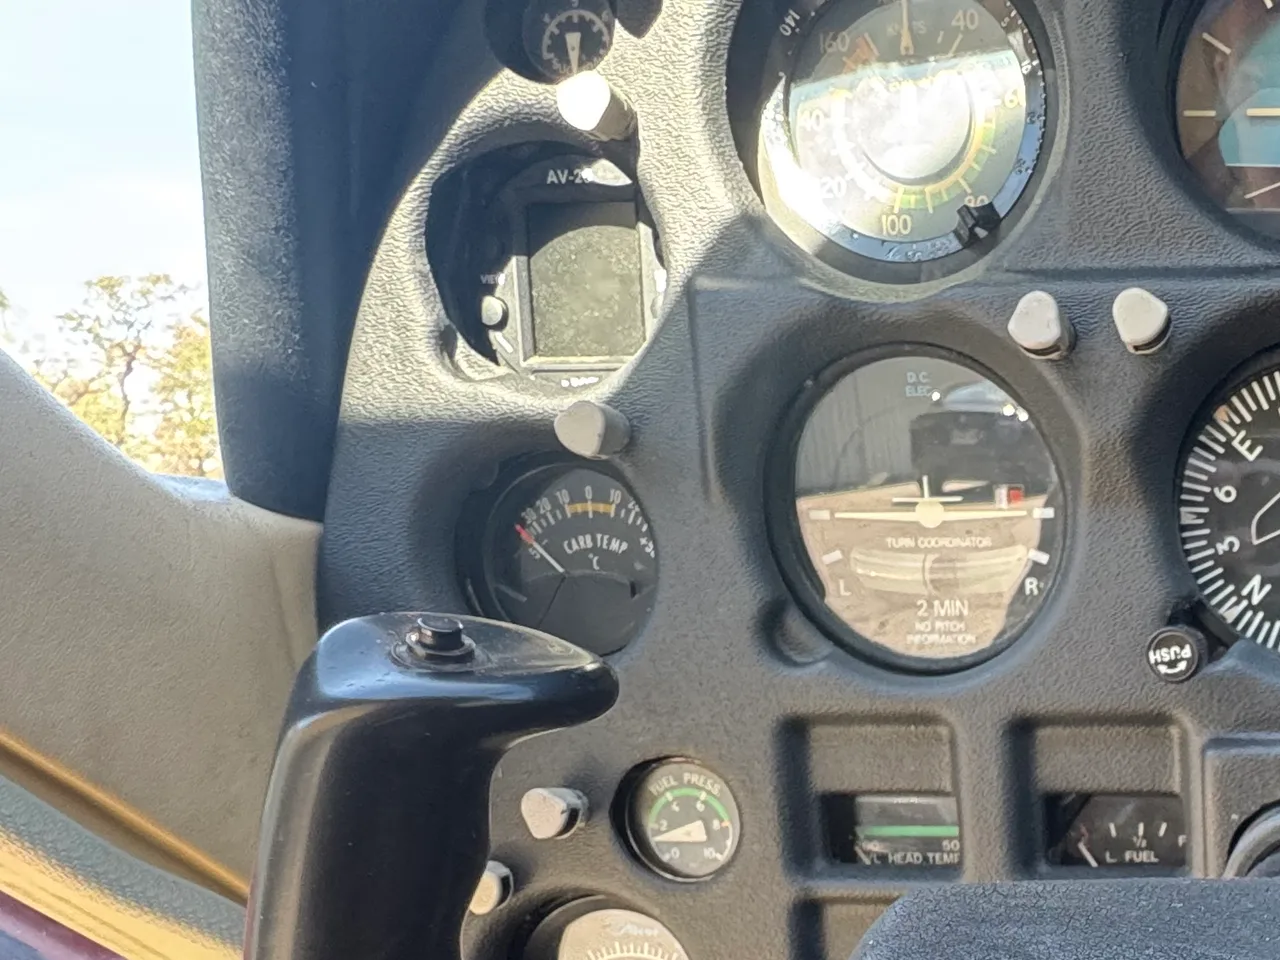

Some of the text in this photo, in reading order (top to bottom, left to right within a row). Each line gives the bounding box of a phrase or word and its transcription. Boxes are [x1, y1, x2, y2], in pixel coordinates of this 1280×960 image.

[951, 9, 979, 30] 40
[880, 214, 912, 236] 100
[1231, 429, 1264, 462] E
[555, 488, 571, 505] 10
[609, 488, 622, 504] 10
[563, 533, 593, 555] CARB
[595, 533, 629, 555] TEMP
[886, 536, 993, 549] TURN COORDINATOR
[1215, 536, 1241, 556] 3
[839, 579, 852, 597] L
[1024, 576, 1039, 596] R
[915, 599, 970, 617] 2 MIN
[1148, 643, 1193, 665] PUSH
[648, 774, 679, 796] FUEL
[888, 851, 924, 865] HEAD
[1104, 849, 1160, 864] L FUEL
